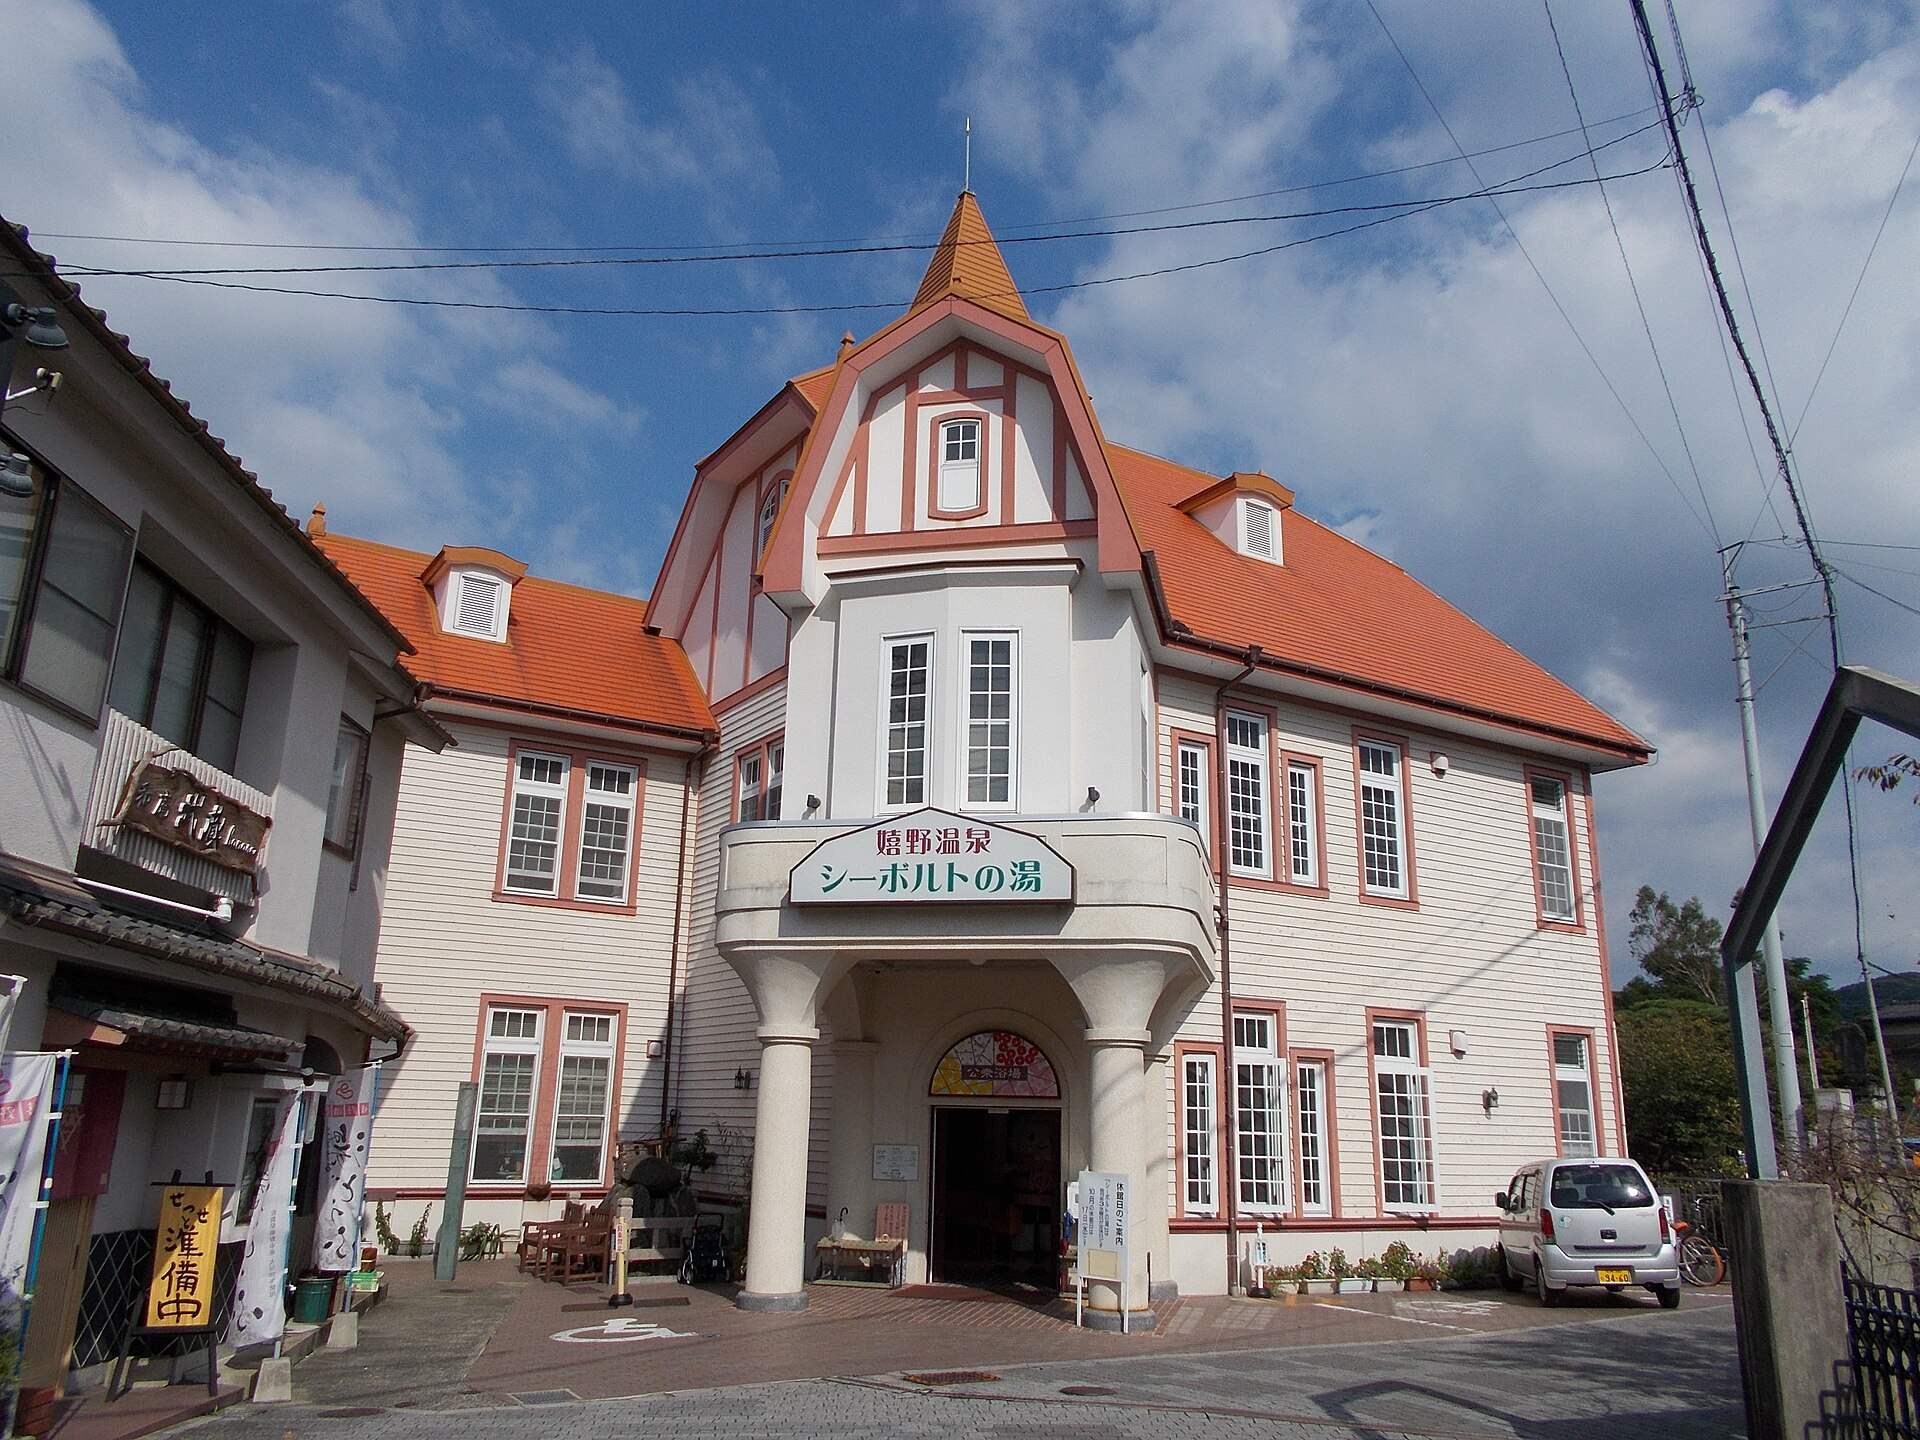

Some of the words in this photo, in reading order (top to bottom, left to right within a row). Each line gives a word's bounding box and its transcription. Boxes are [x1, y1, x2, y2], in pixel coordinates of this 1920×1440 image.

[876, 827, 992, 856] 嬉野温泉
[820, 860, 1041, 893] シーボルトの湯
[1115, 1182, 1124, 1246] 休館日のご案内
[157, 1228, 204, 1324] 準備中
